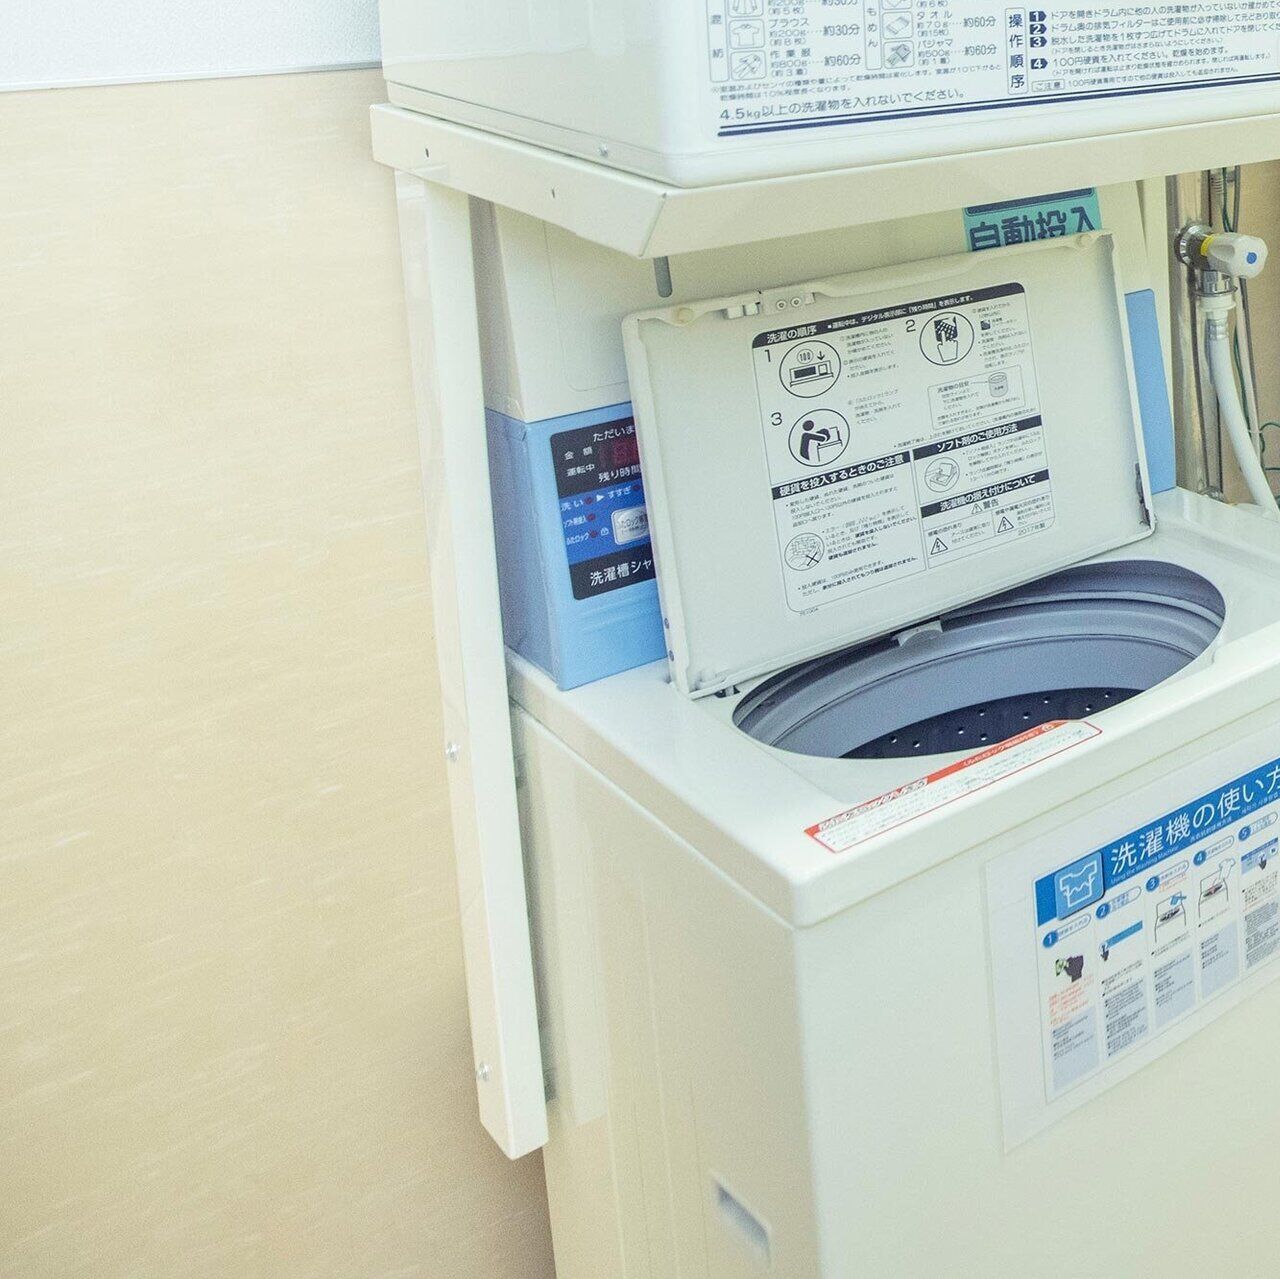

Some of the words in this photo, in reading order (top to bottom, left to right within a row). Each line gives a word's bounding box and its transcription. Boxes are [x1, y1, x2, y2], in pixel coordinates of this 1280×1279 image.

[769, 17, 810, 28] ブラウス
[916, 10, 953, 21] タオル
[963, 16, 996, 28] 約60分
[822, 23, 861, 37] 約30分
[917, 38, 953, 48] パジャマ
[964, 45, 997, 56] 約60分
[1009, 13, 1025, 89] 操作順序
[1052, 46, 1229, 67] 100円硬貨を入れてください。乾燥を始めます。
[824, 54, 861, 67] 約60分
[1035, 79, 1062, 91] ご注意
[719, 89, 967, 121] 4.5kg以上の洗濯物を入れないでください。
[968, 206, 1100, 251] 自動投入
[906, 319, 916, 333] 2
[767, 325, 817, 344] 洗濯の順序
[764, 349, 771, 363] 1
[770, 411, 783, 426] 3
[593, 424, 635, 442] ただいま
[937, 423, 1018, 452] ソフト剤のご使用方法
[566, 463, 595, 477] 運転中
[779, 455, 904, 496] 硬貨を投入するときのご注意
[607, 485, 631, 500] すすぎ
[940, 475, 1036, 512] 洗濯機の据え付けについて
[983, 499, 999, 511] 警告
[1241, 828, 1248, 839] 5
[1149, 878, 1157, 888] 3
[1099, 907, 1106, 918] 2
